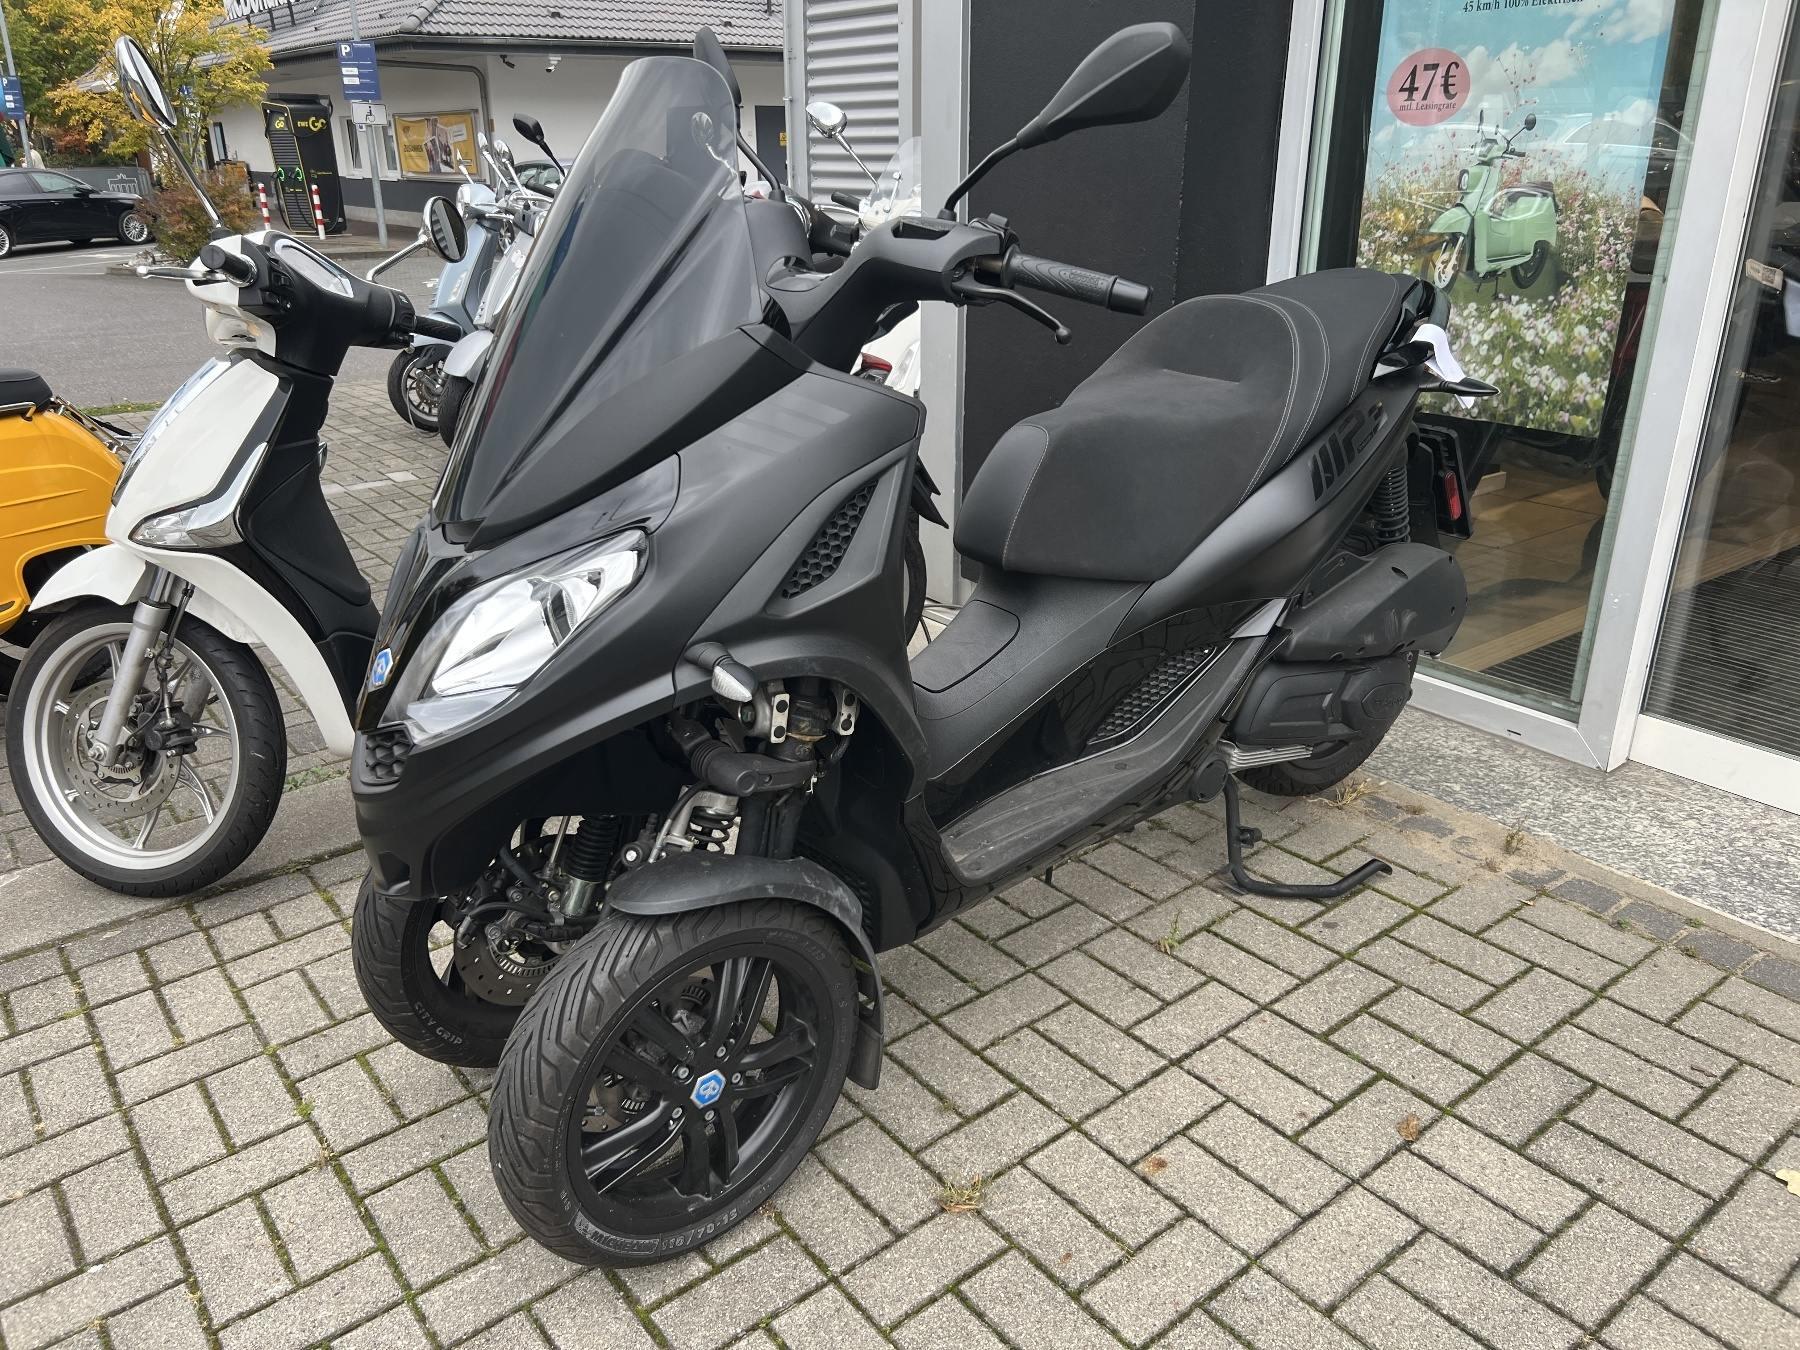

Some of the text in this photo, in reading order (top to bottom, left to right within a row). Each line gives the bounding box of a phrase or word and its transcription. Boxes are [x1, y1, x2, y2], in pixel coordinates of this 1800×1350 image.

[1463, 1, 1474, 13] 45
[1476, 0, 1500, 12] km/h
[341, 44, 351, 56] P
[1398, 61, 1460, 102] 47€
[1416, 101, 1457, 113] Leasingrate
[436, 1026, 463, 1045] GRIP
